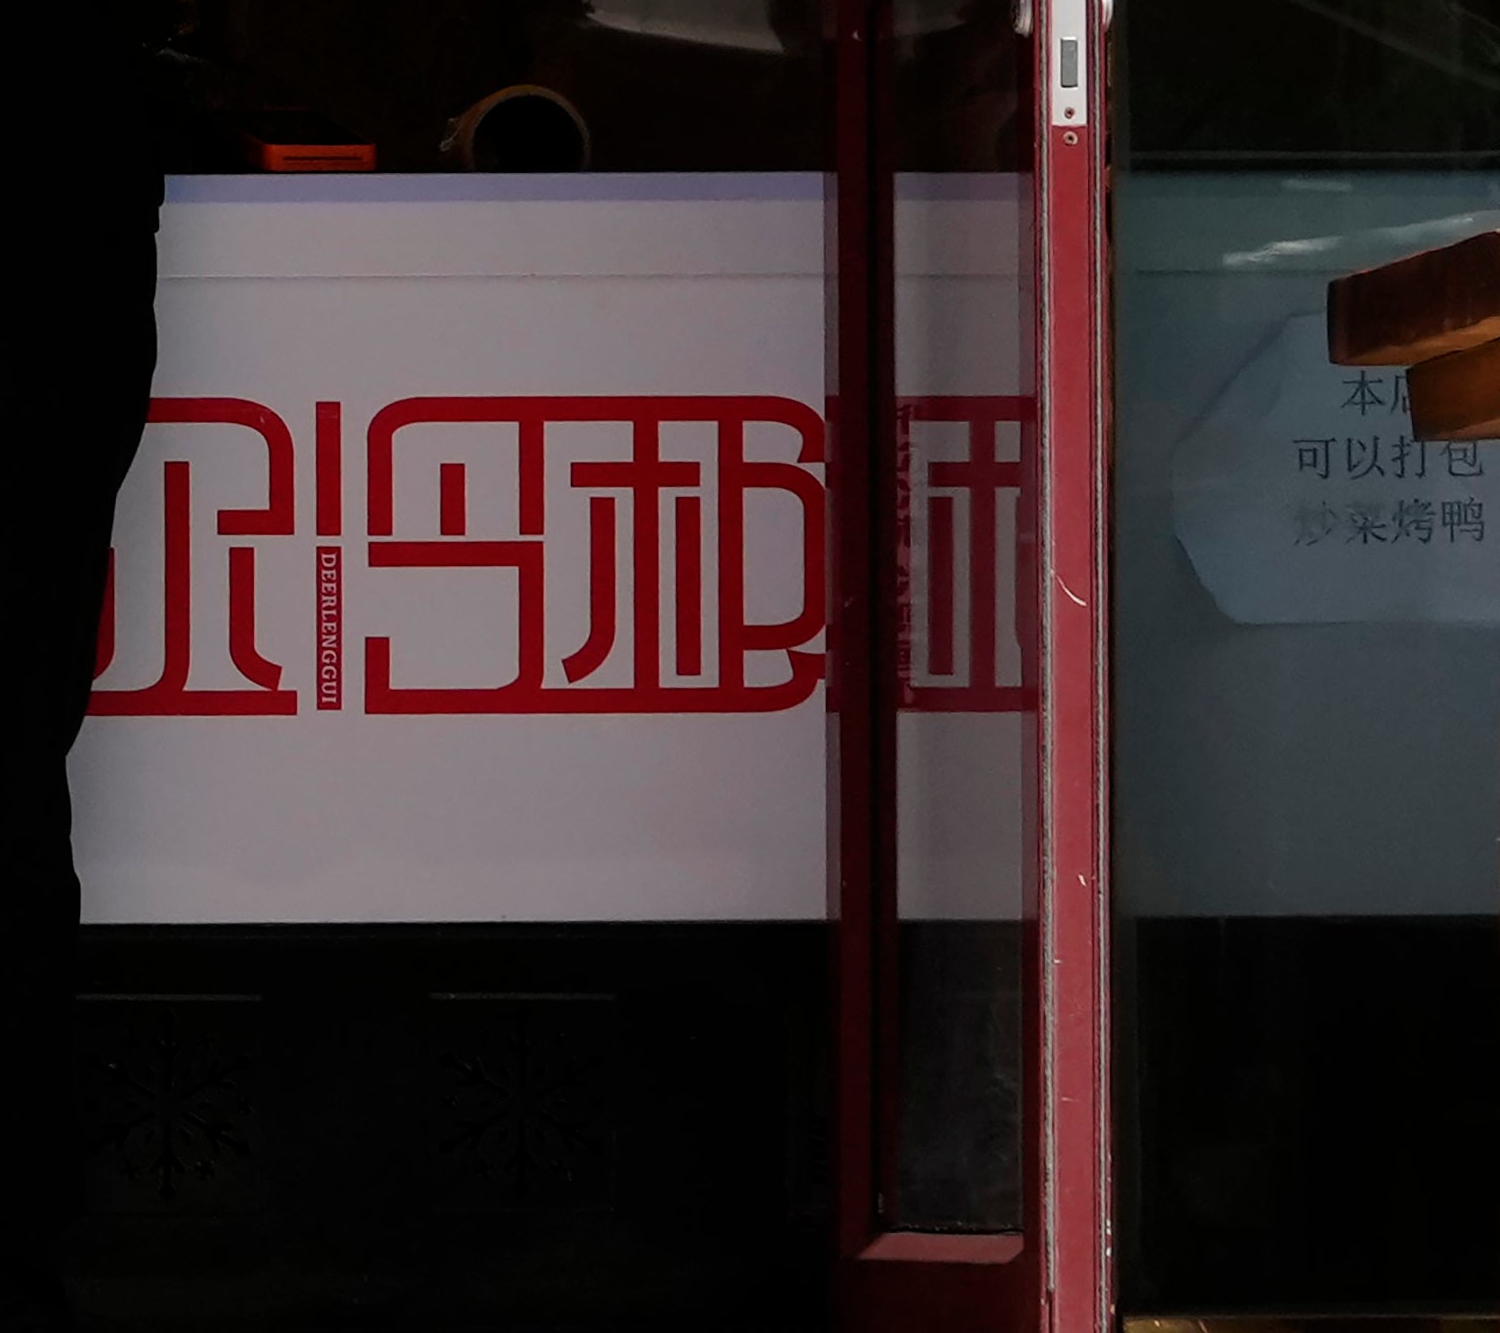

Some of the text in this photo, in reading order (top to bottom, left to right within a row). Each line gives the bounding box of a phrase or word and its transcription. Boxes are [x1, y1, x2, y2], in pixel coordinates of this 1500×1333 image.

[1293, 437, 1484, 480] 可以打包
[320, 552, 338, 705] DEERLENGGUI
